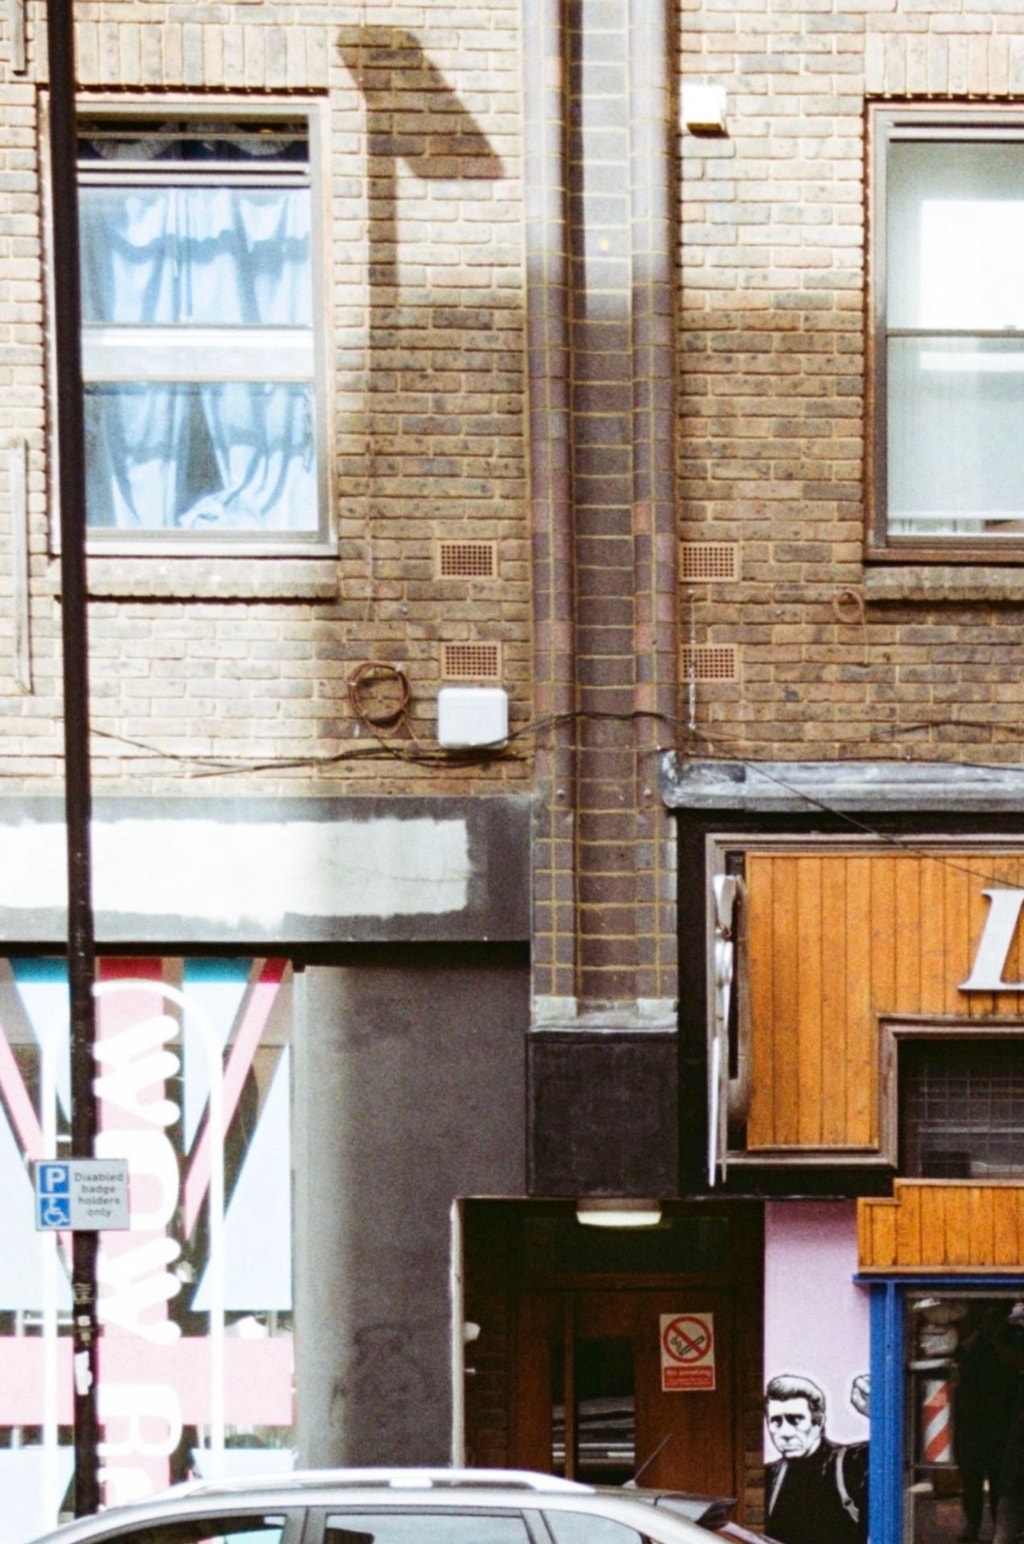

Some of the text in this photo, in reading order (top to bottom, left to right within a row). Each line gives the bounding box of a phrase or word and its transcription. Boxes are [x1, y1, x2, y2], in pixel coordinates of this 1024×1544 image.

[46, 1167, 66, 1192] P
[74, 1172, 123, 1182] Disabled
[82, 1184, 116, 1195] badge
[78, 1197, 120, 1205] holders
[88, 1208, 112, 1217] only
